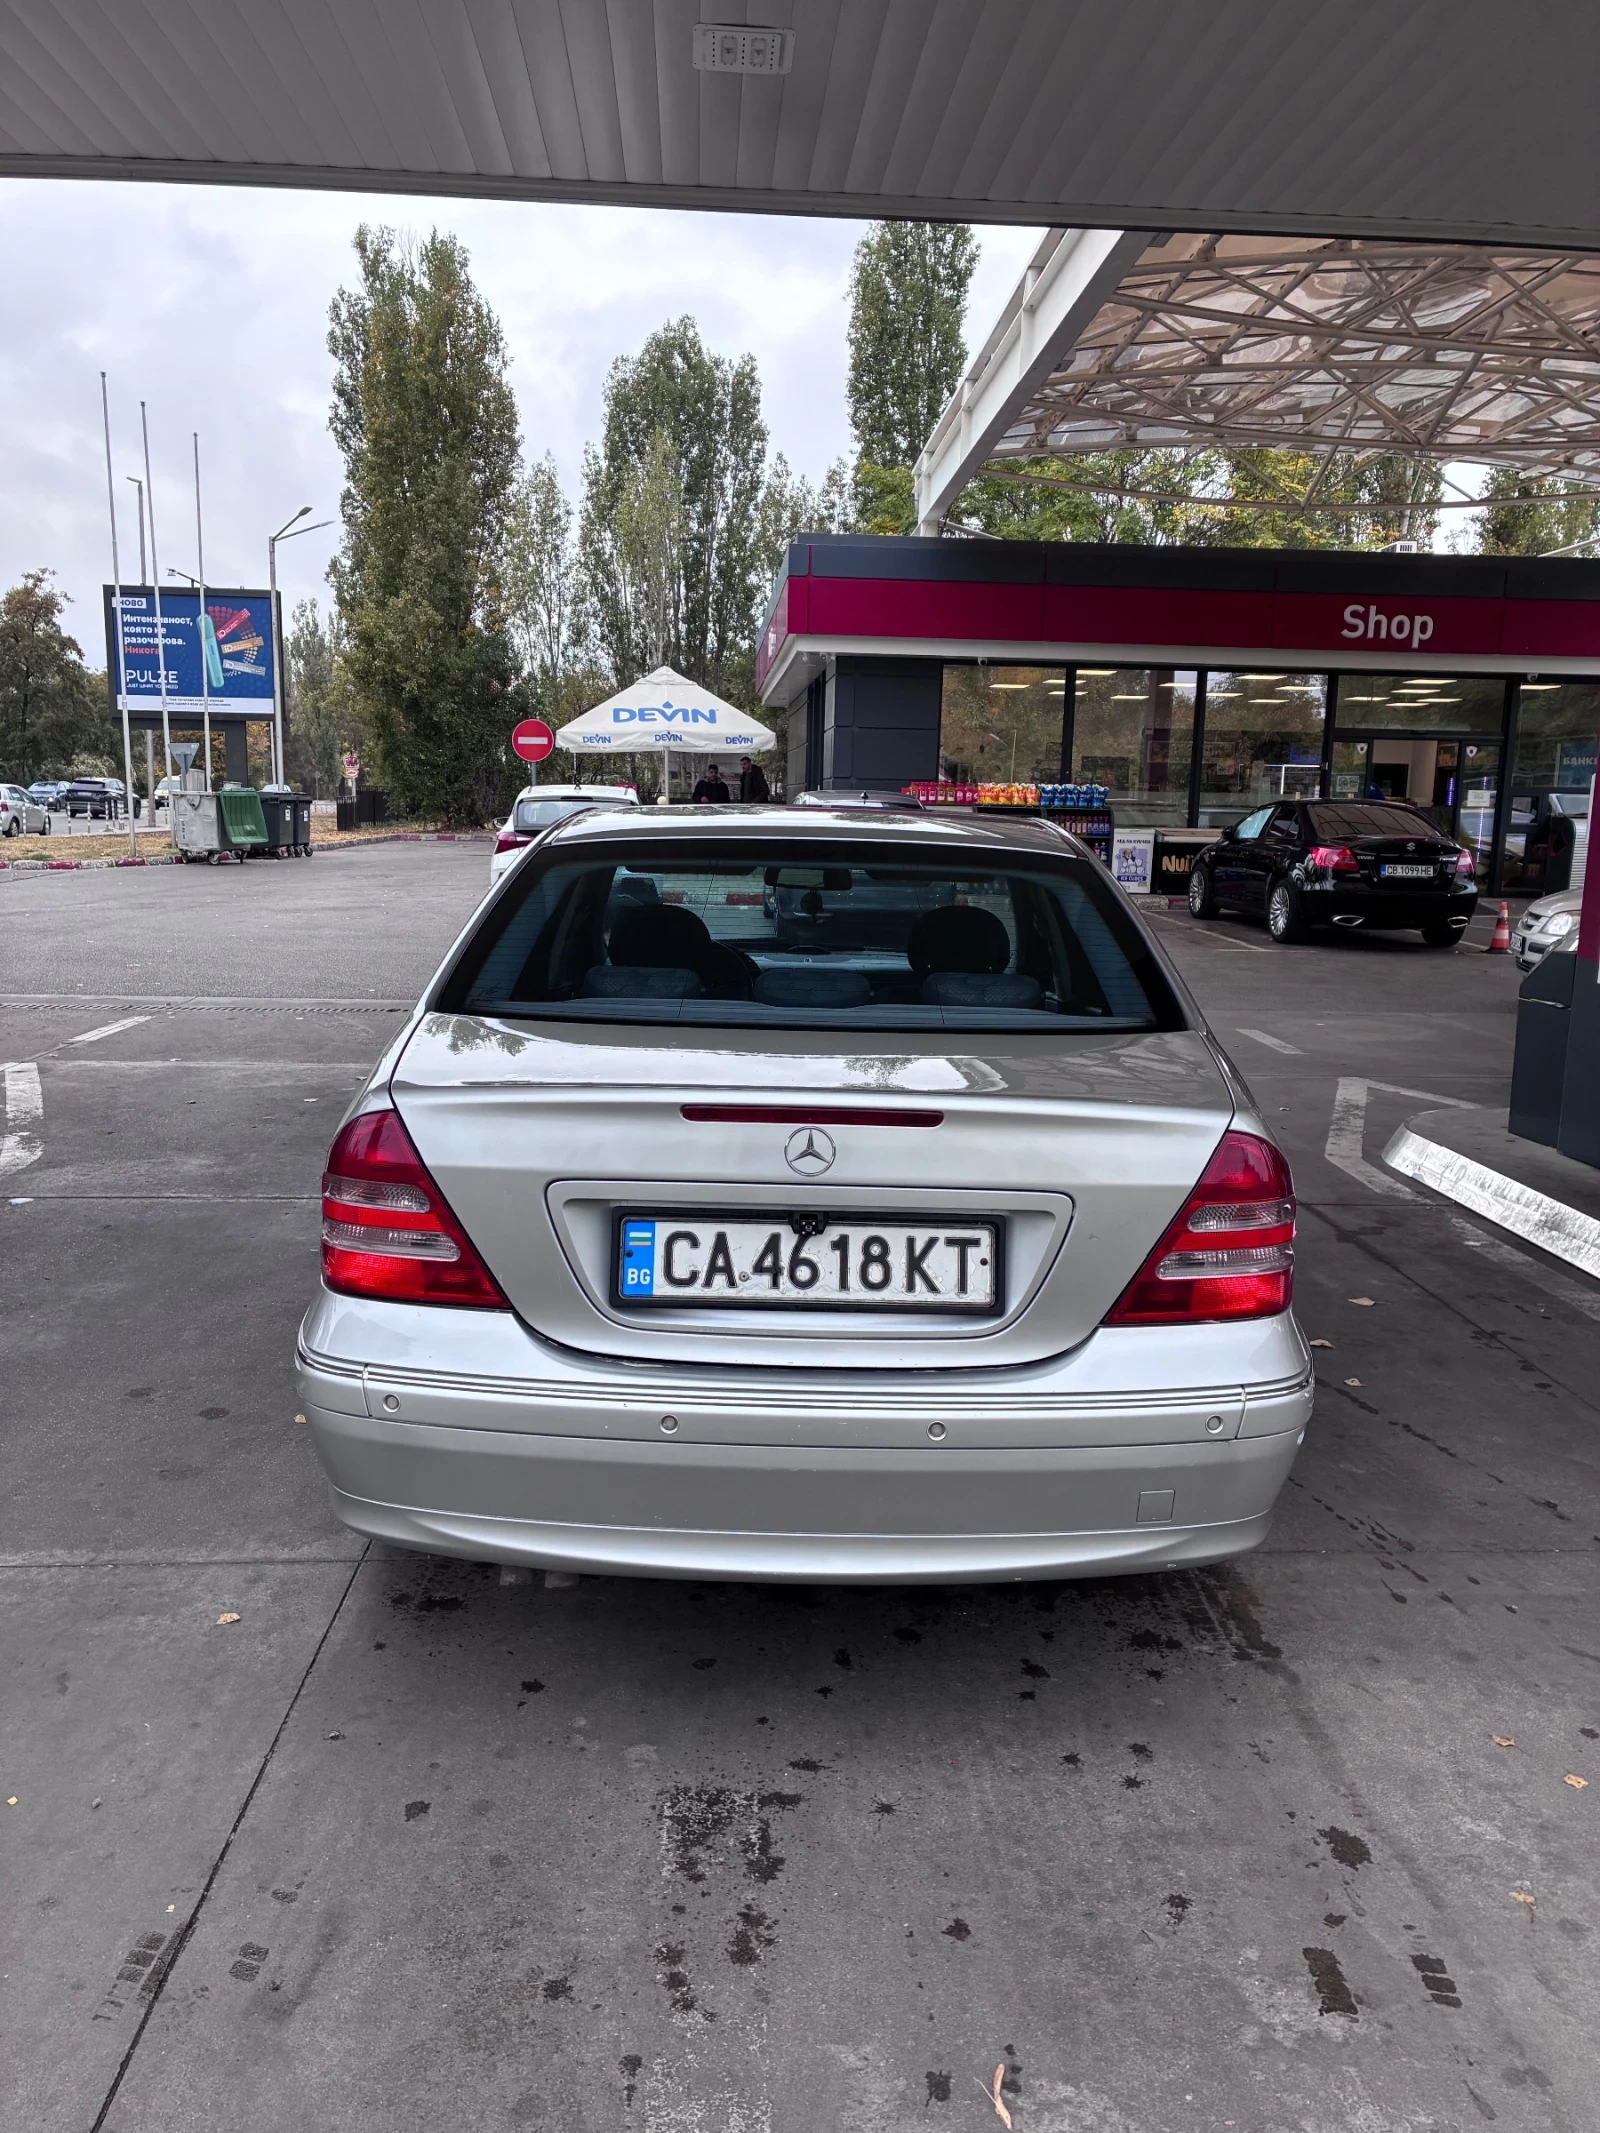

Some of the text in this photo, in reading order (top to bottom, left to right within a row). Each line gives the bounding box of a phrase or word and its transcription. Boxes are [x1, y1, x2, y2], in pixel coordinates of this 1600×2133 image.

[124, 626, 153, 634] която
[1340, 604, 1434, 649] Shop
[124, 645, 160, 655] Никога
[126, 669, 179, 684] PULZE
[612, 705, 718, 724] DEVIN
[582, 733, 754, 745] DEVIN DEVIN DEVIN
[626, 1267, 651, 1285] BG
